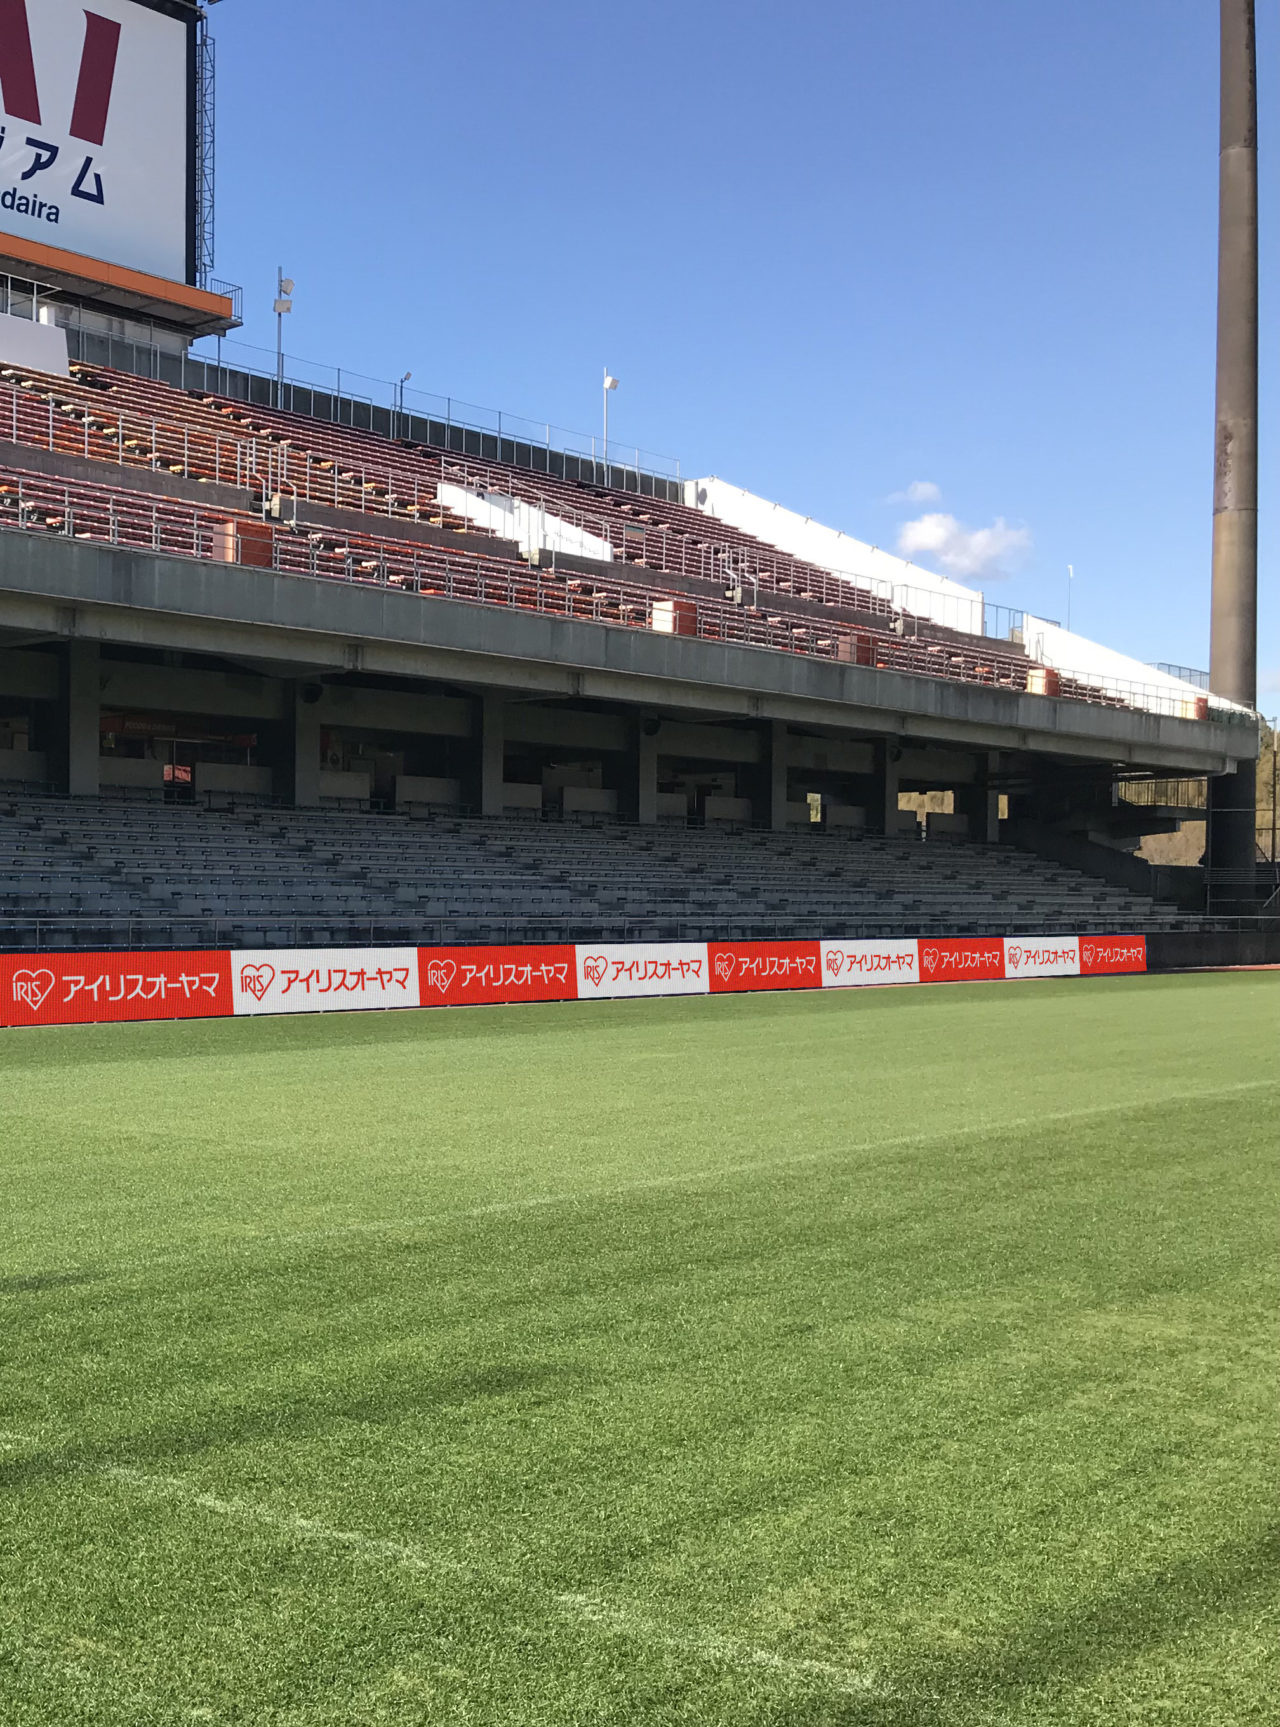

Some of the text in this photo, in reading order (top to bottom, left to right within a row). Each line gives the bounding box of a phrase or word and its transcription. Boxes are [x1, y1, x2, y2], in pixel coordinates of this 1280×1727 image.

[739, 957, 815, 976] アイリスオーヤマ
[847, 954, 913, 972] アイリスオーヤマ
[940, 952, 999, 968] アイリスオーヤマ
[1024, 950, 1075, 965] アイリスオーヤマ
[281, 968, 409, 993] アイリスオーヤマ
[461, 964, 567, 986] アイリスオーヤマ
[612, 960, 702, 981] アイリスオーヤマ
[62, 973, 219, 1002] アイリスオーヤマ
